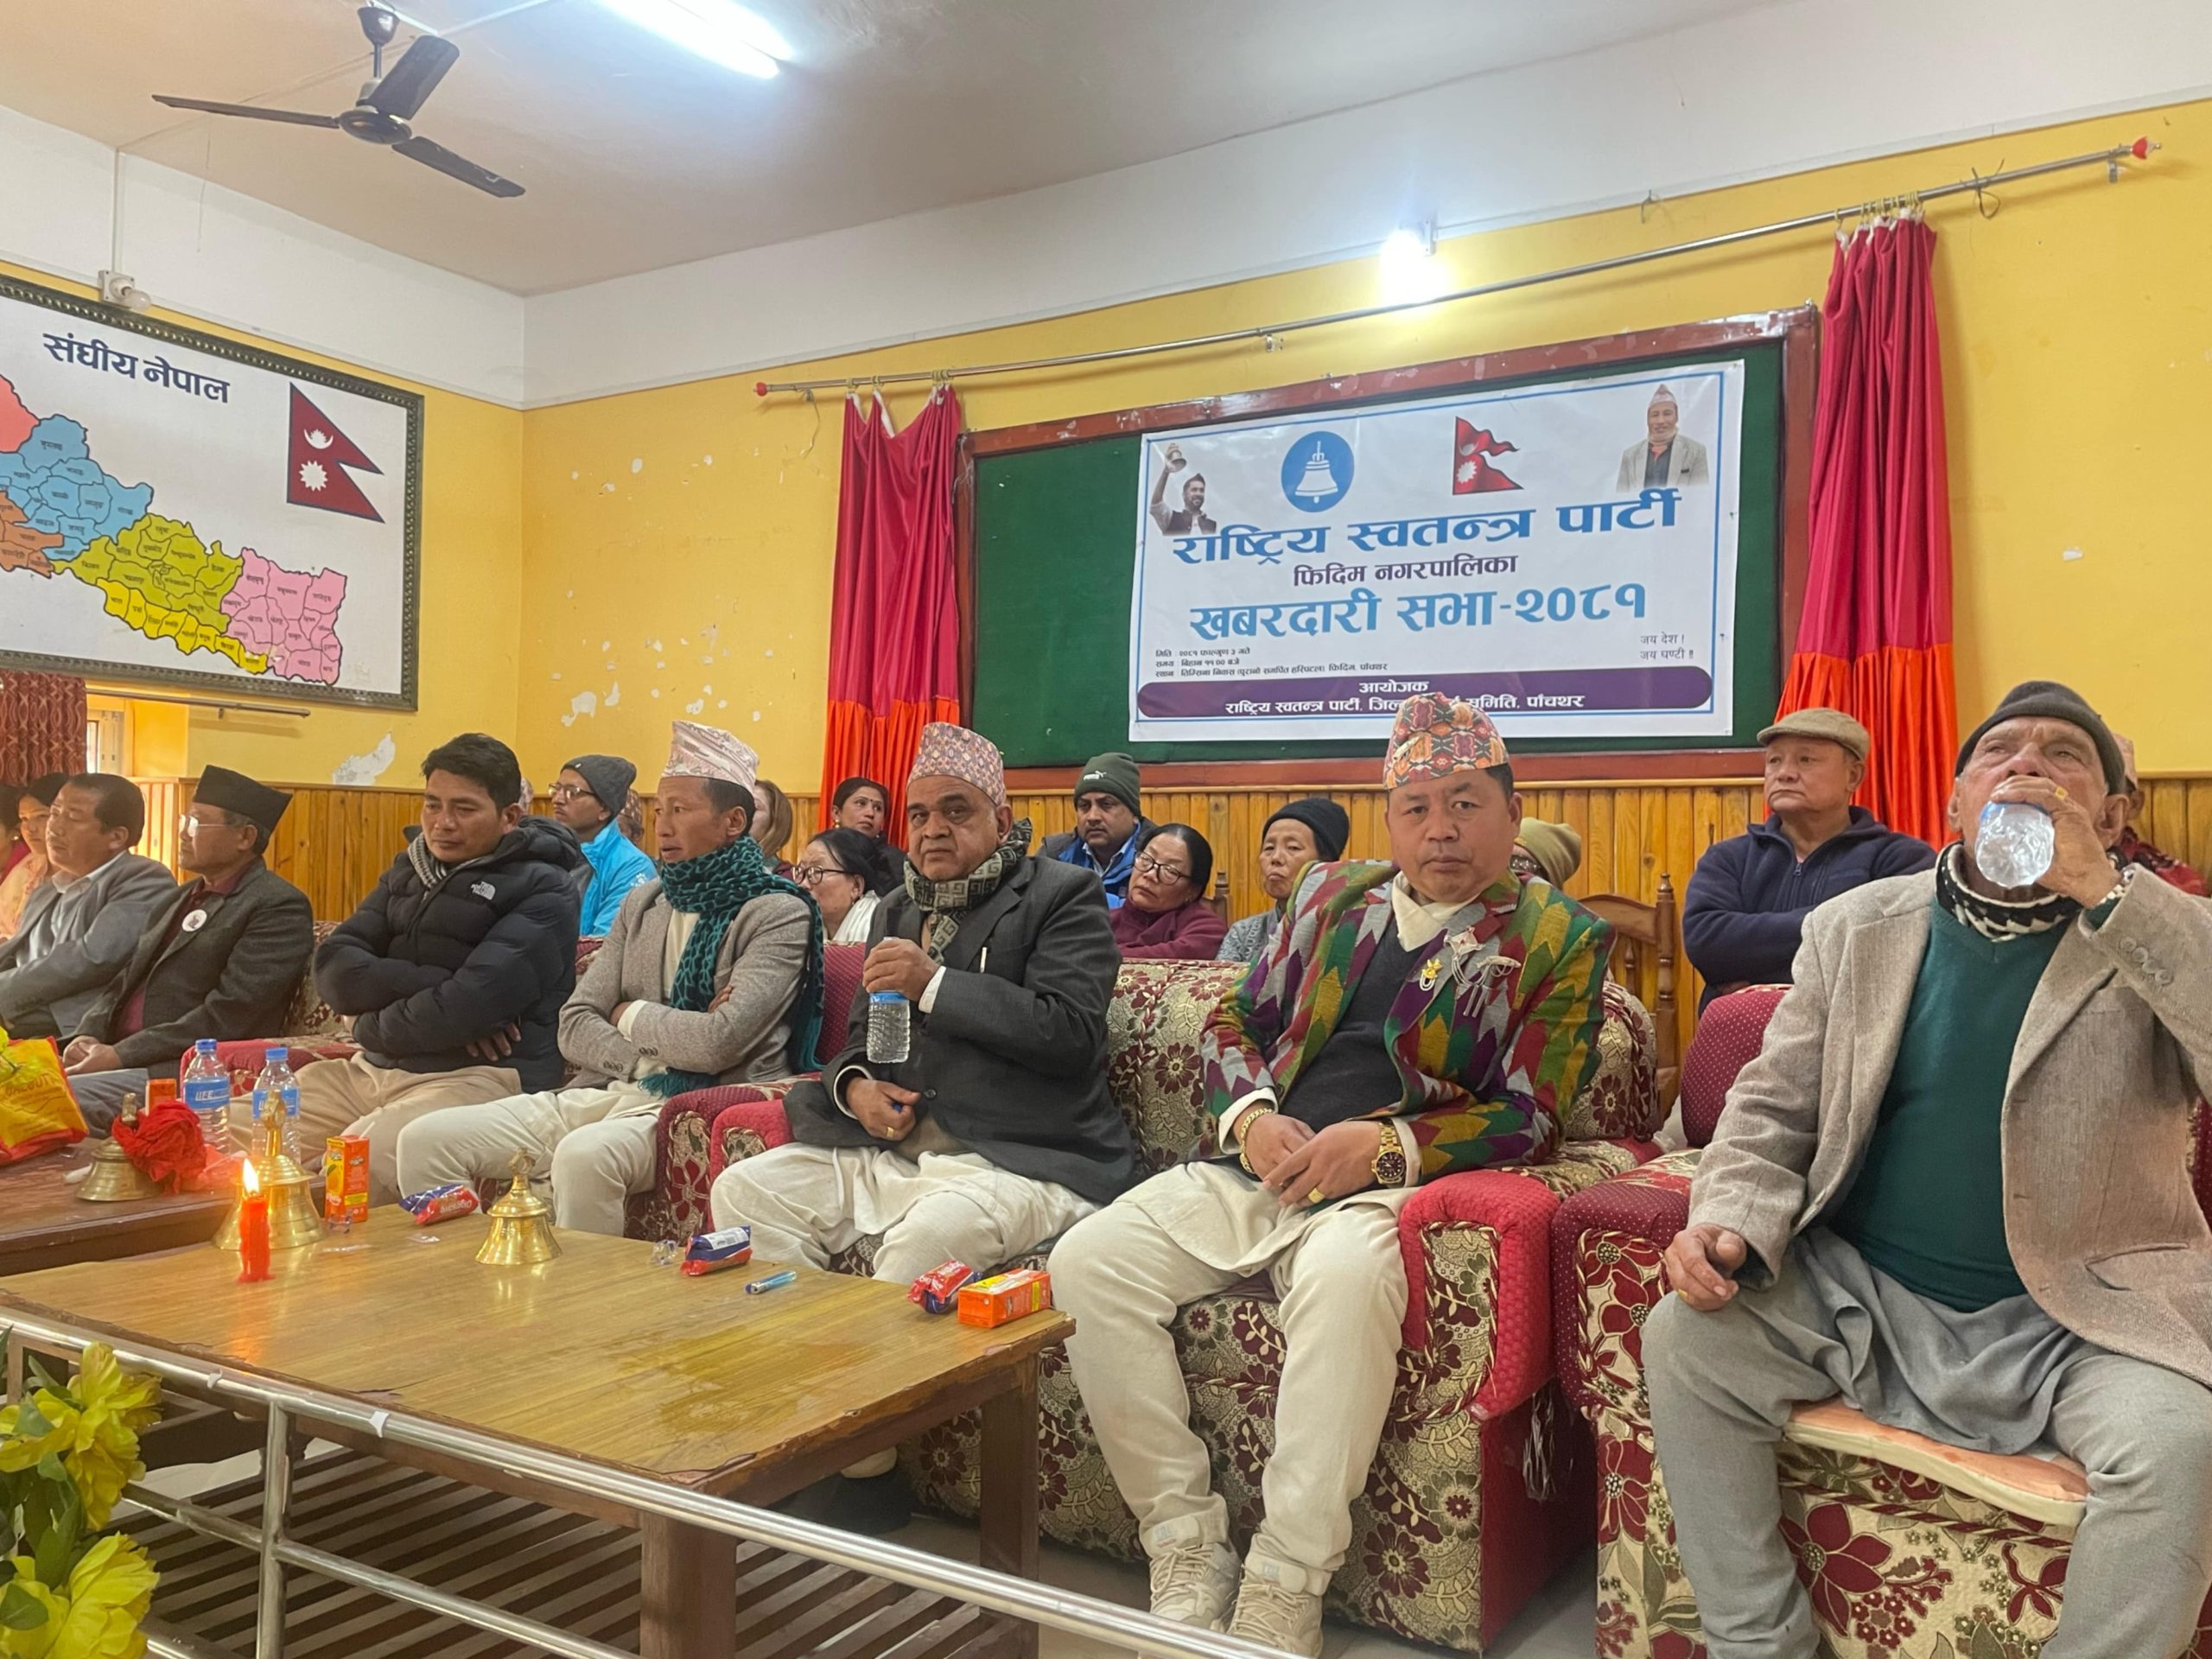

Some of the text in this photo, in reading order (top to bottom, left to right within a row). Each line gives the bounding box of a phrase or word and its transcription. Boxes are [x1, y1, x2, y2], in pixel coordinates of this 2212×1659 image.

[42, 332, 231, 404] संघीय नेपाल
[1173, 487, 1681, 565] राष्ट्रिय स्वतन्त्र पार्टी
[1294, 553, 1518, 587] फिदिम नगरपालिका
[1190, 588, 1382, 640] खबरदारी
[1640, 635, 1657, 645] जय
[1661, 631, 1678, 645] देश
[1639, 651, 1657, 660] जय
[1359, 679, 1429, 693] आयोजक
[1224, 700, 1271, 715] राष्ट्रिय
[1275, 700, 1324, 714] स्वतन्त्र
